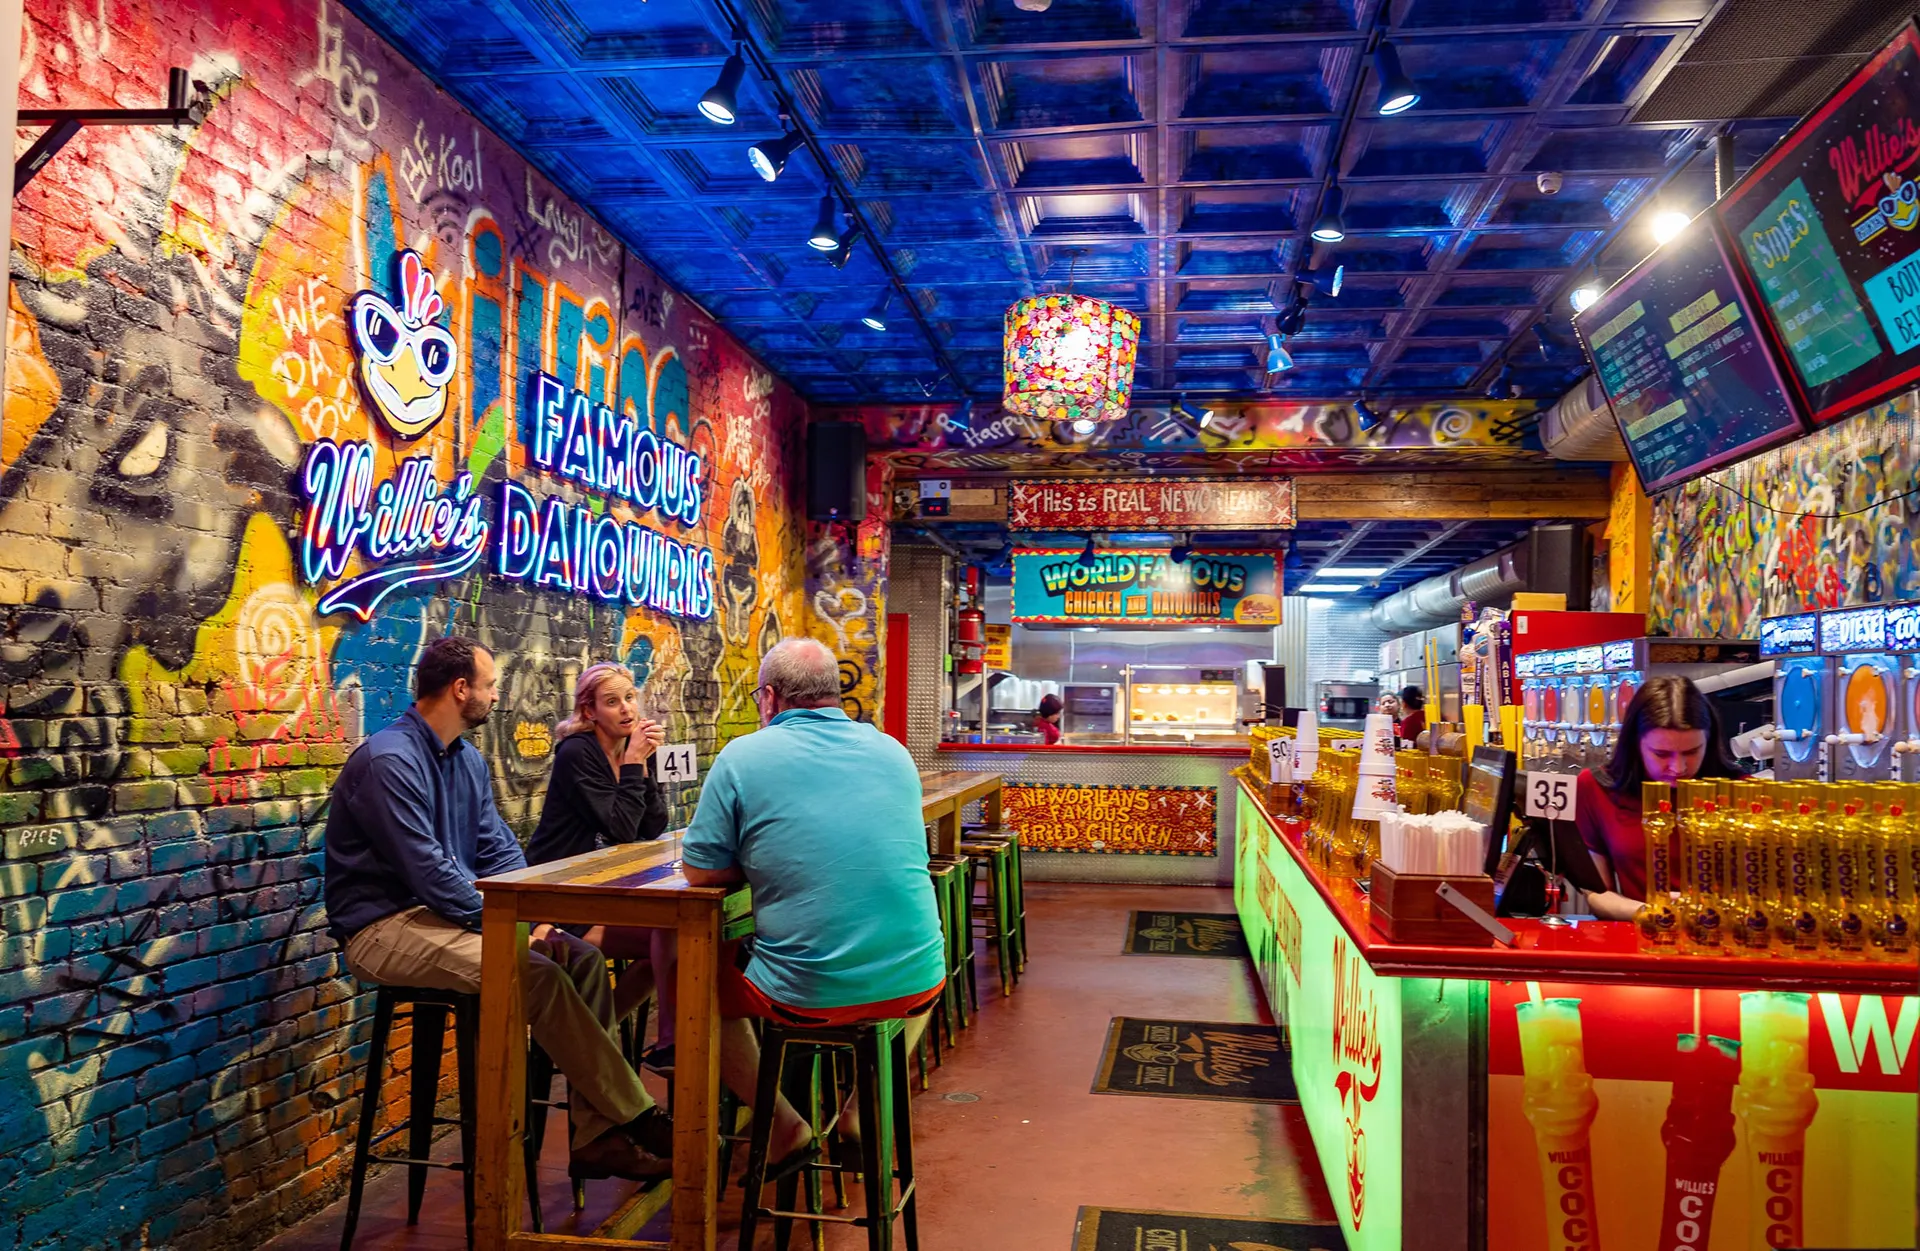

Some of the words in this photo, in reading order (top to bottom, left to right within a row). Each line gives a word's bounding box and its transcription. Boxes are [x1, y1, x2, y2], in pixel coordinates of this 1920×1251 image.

[1753, 199, 1810, 269] SIDES
[272, 274, 336, 340] WE
[529, 371, 701, 527] FAMOUS
[303, 437, 489, 584] Willie's
[1102, 487, 1151, 513] REAL
[492, 479, 714, 622] DAIQUIRIS
[1042, 554, 1136, 592] WORLD
[1138, 552, 1245, 593] FAMOUS
[1063, 591, 1122, 615] CHICKEN
[1152, 591, 1222, 615] DAIQUIRIS
[1501, 661, 1512, 704] ABITA
[664, 751, 690, 775] 41
[1049, 804, 1131, 823] FAMOUS
[1534, 780, 1568, 811] 35
[19, 828, 61, 848] RICE
